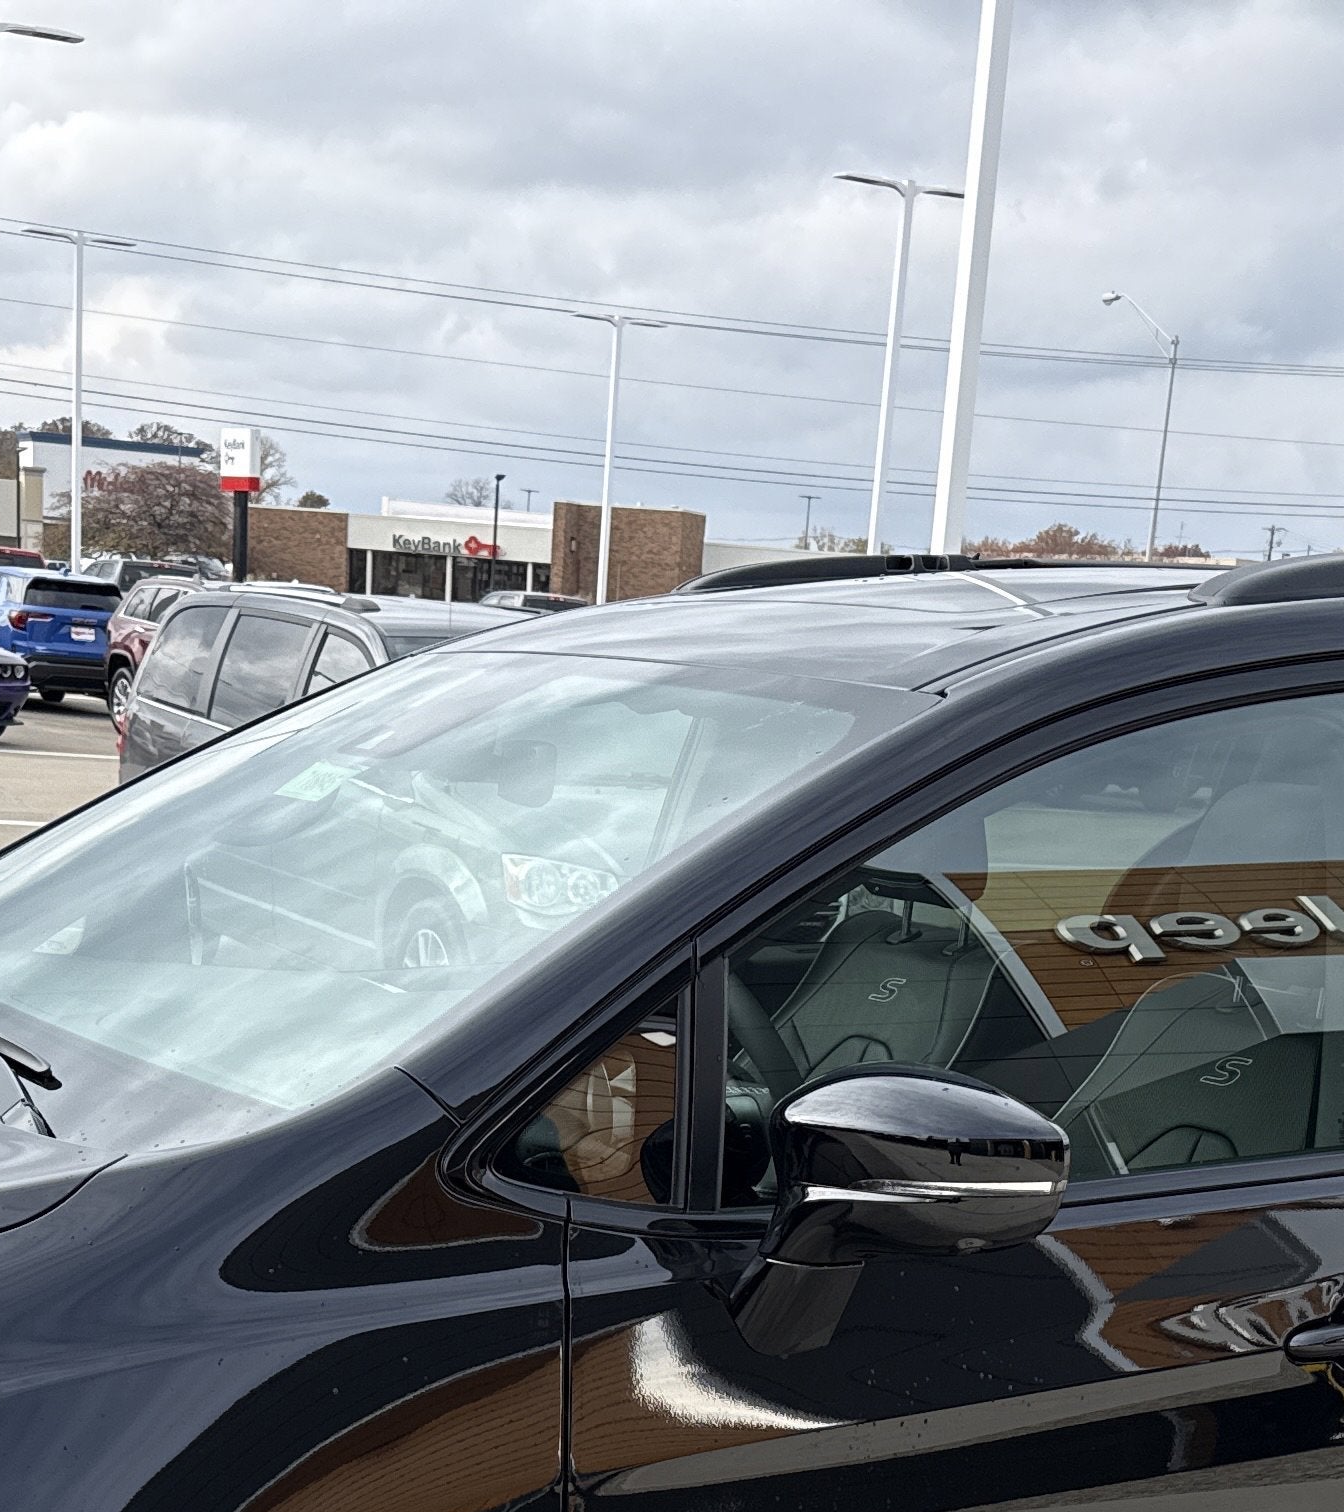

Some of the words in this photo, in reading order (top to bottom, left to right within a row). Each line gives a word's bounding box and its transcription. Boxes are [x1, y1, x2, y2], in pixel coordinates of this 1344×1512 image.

[392, 533, 463, 554] KeyBank
[867, 977, 907, 1003] S
[1200, 1056, 1253, 1087] S
